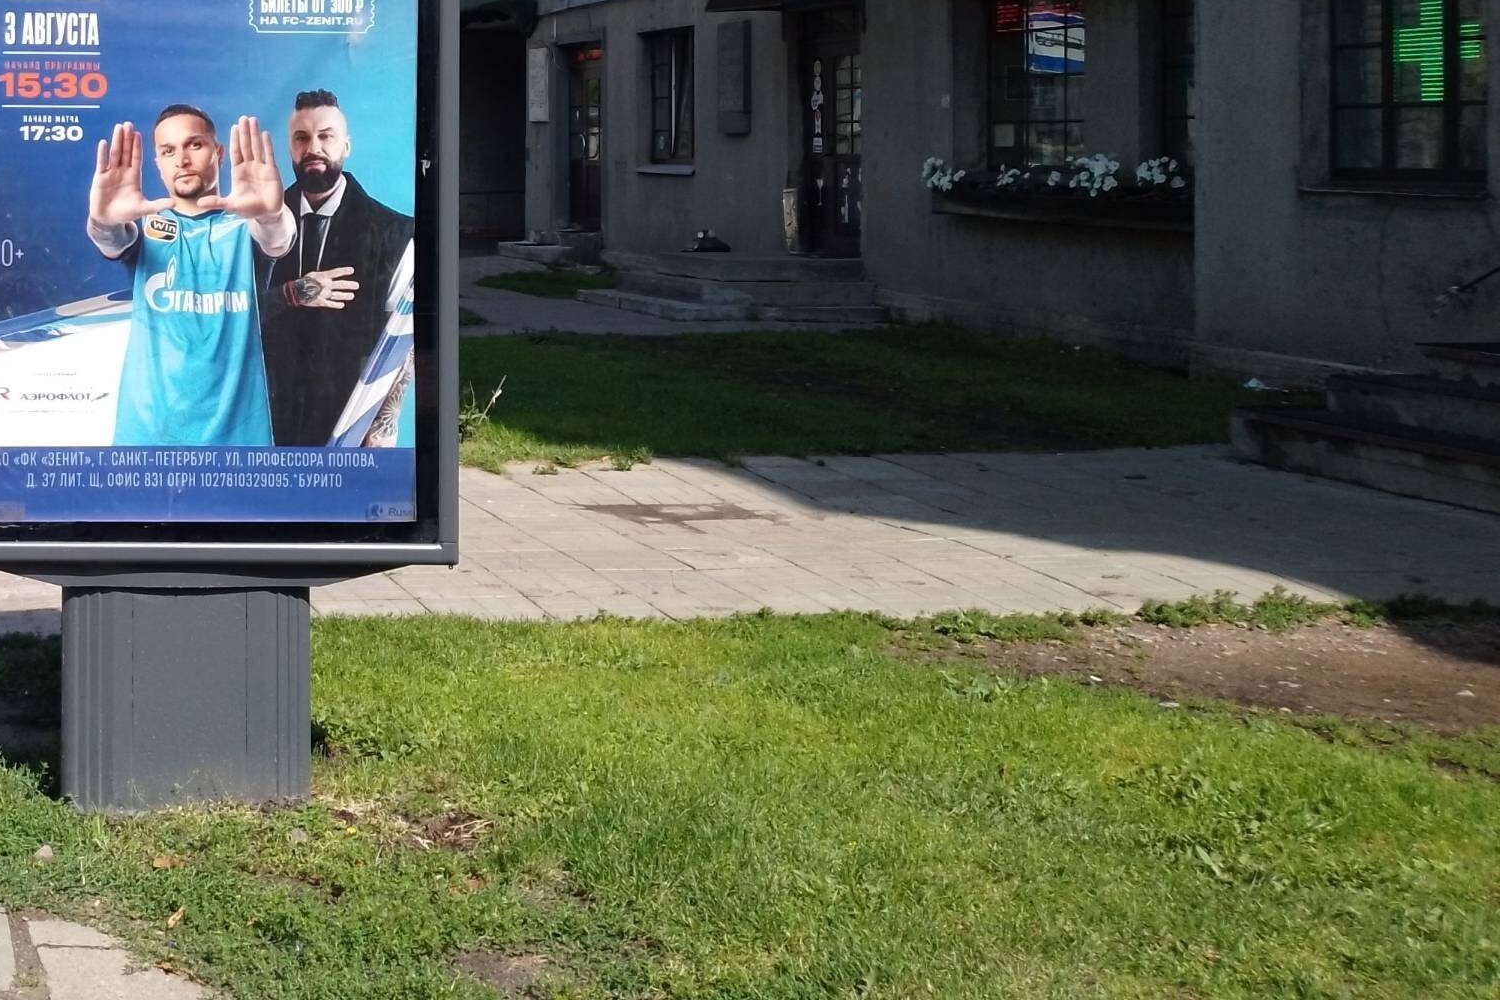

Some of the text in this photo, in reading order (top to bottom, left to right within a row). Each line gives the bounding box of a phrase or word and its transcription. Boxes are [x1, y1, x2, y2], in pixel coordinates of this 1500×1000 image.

[4, 11, 100, 45] 3 АВГУСТА
[260, 16, 363, 26] НА FC-ZENIT.RU
[0, 72, 108, 98] 15:30
[55, 115, 80, 123] МАТЧА
[20, 125, 83, 141] 17:30
[2, 239, 24, 266] 0+
[20, 392, 91, 401] АЭРОФЛОТ
[14, 452, 37, 466] «ФК
[41, 452, 94, 468] «ЗЕНИТ»,
[111, 452, 221, 468] САНКТ-ПЕТЕРБУРГ,
[225, 452, 243, 466] УЛ.
[247, 452, 324, 467] ПРОФЕССОРА
[328, 452, 378, 469] ПОПОВА,
[42, 473, 56, 487] 37
[60, 473, 85, 487] ЛИТ.
[107, 473, 141, 487] ОФИС
[144, 473, 163, 487] 831
[167, 473, 196, 487] ОГРН
